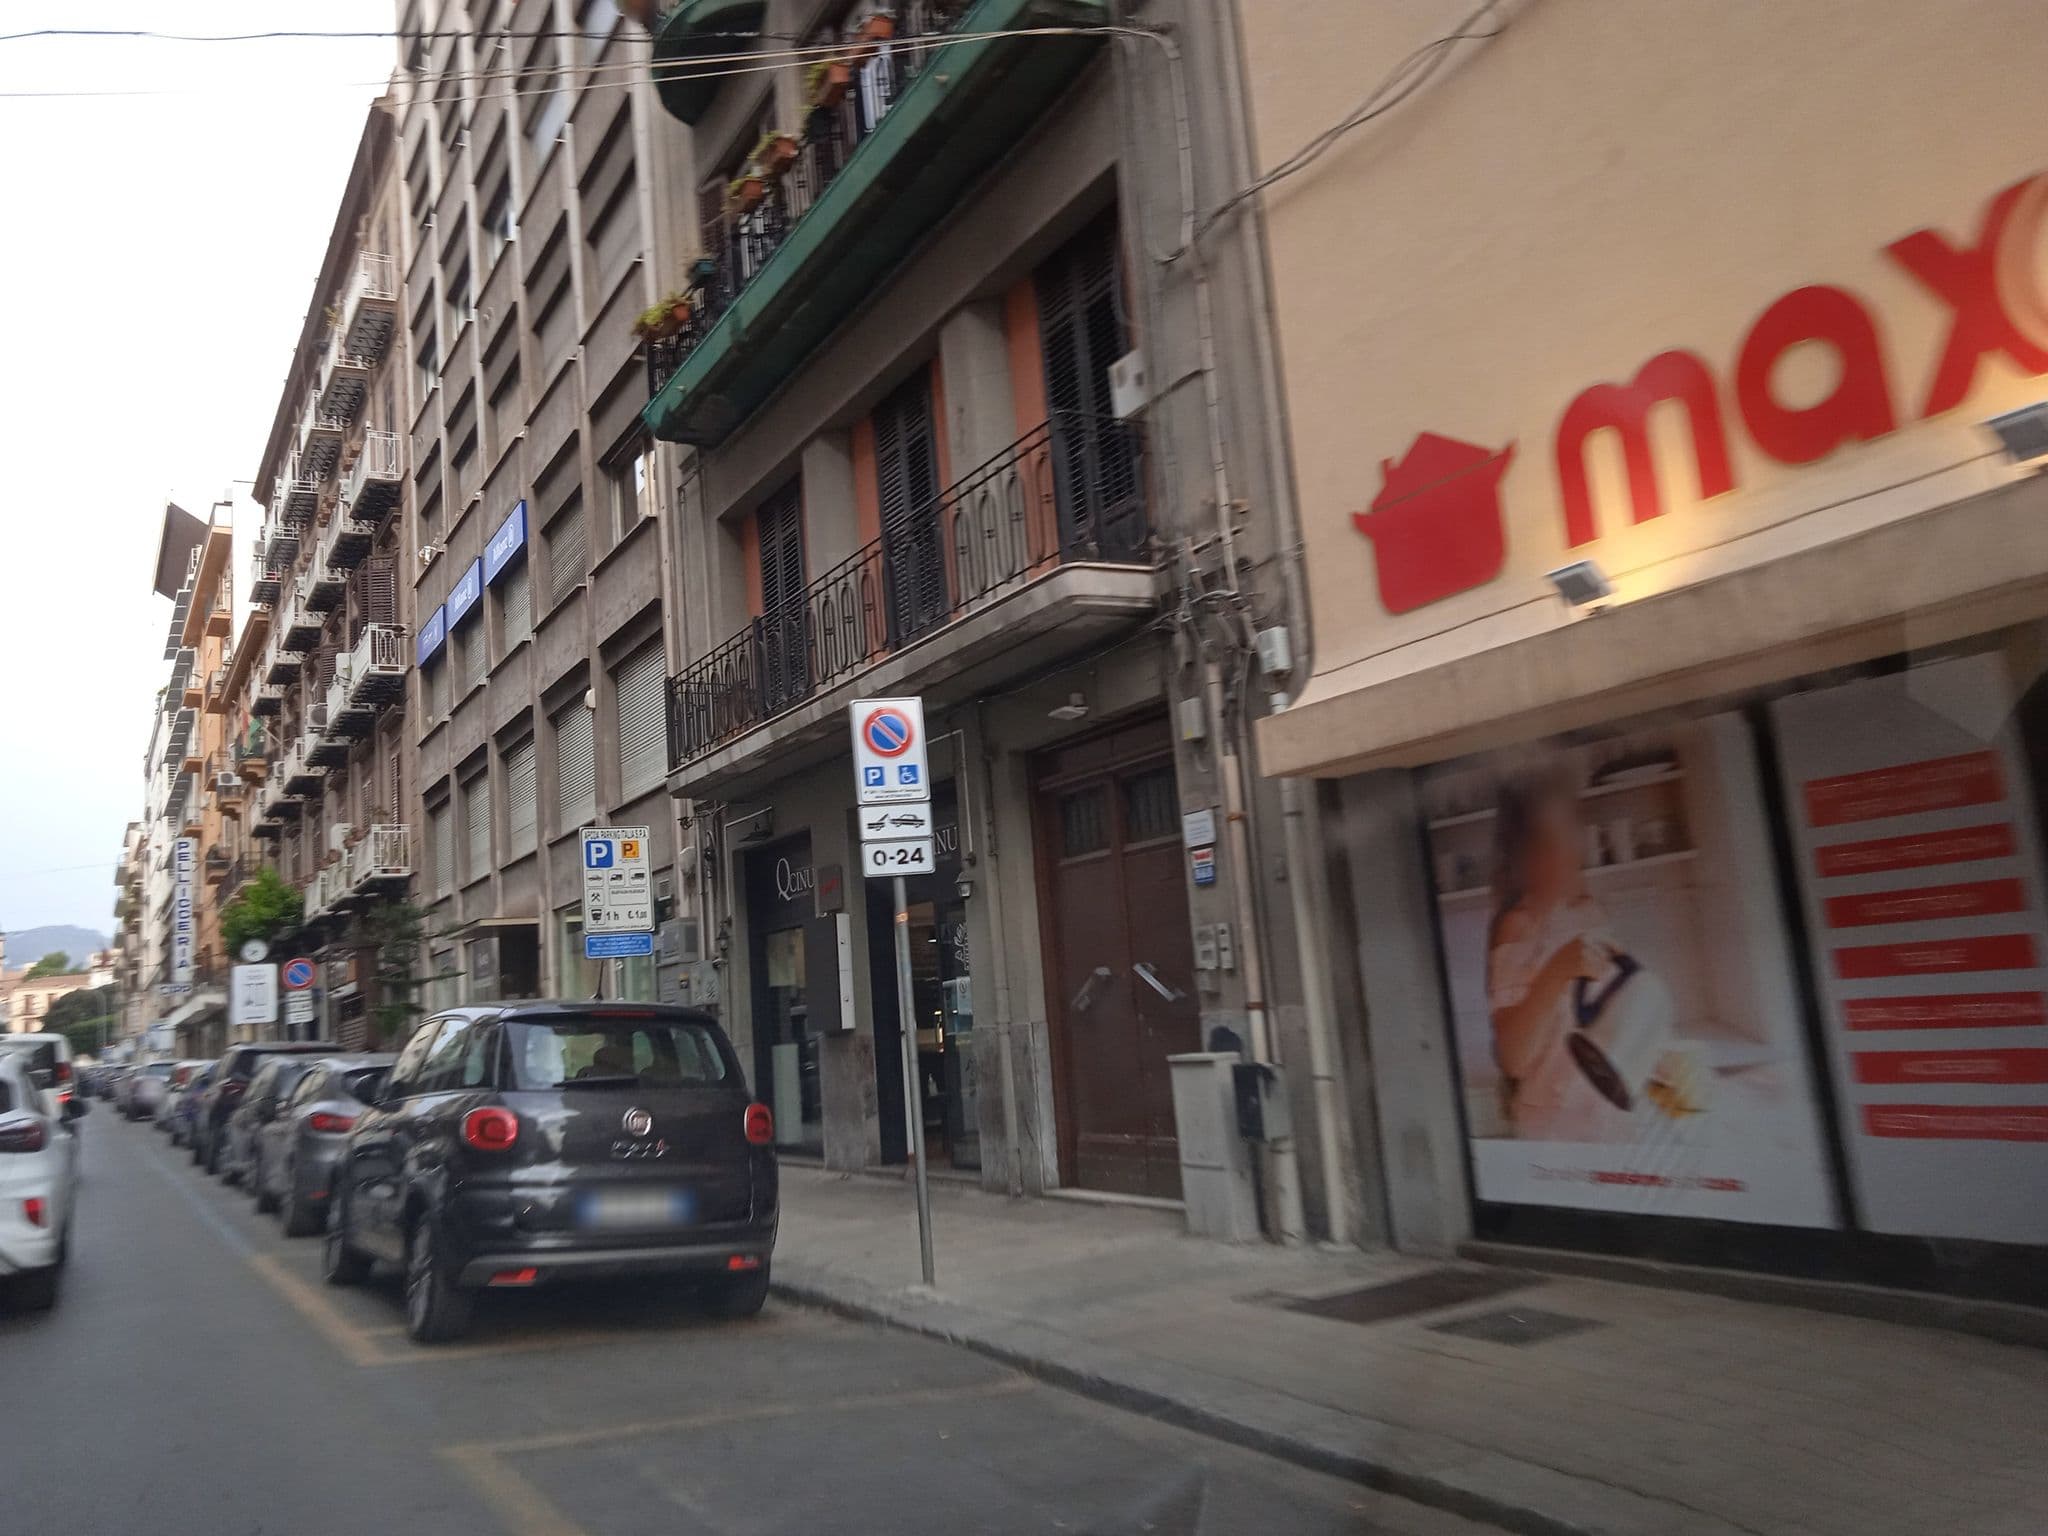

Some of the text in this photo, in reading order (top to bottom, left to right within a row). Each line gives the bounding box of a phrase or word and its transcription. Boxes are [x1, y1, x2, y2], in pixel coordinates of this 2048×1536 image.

[867, 769, 881, 785] P
[590, 843, 608, 866] P
[873, 847, 925, 866] 0-24
[177, 841, 190, 969] PELLICCERIA
